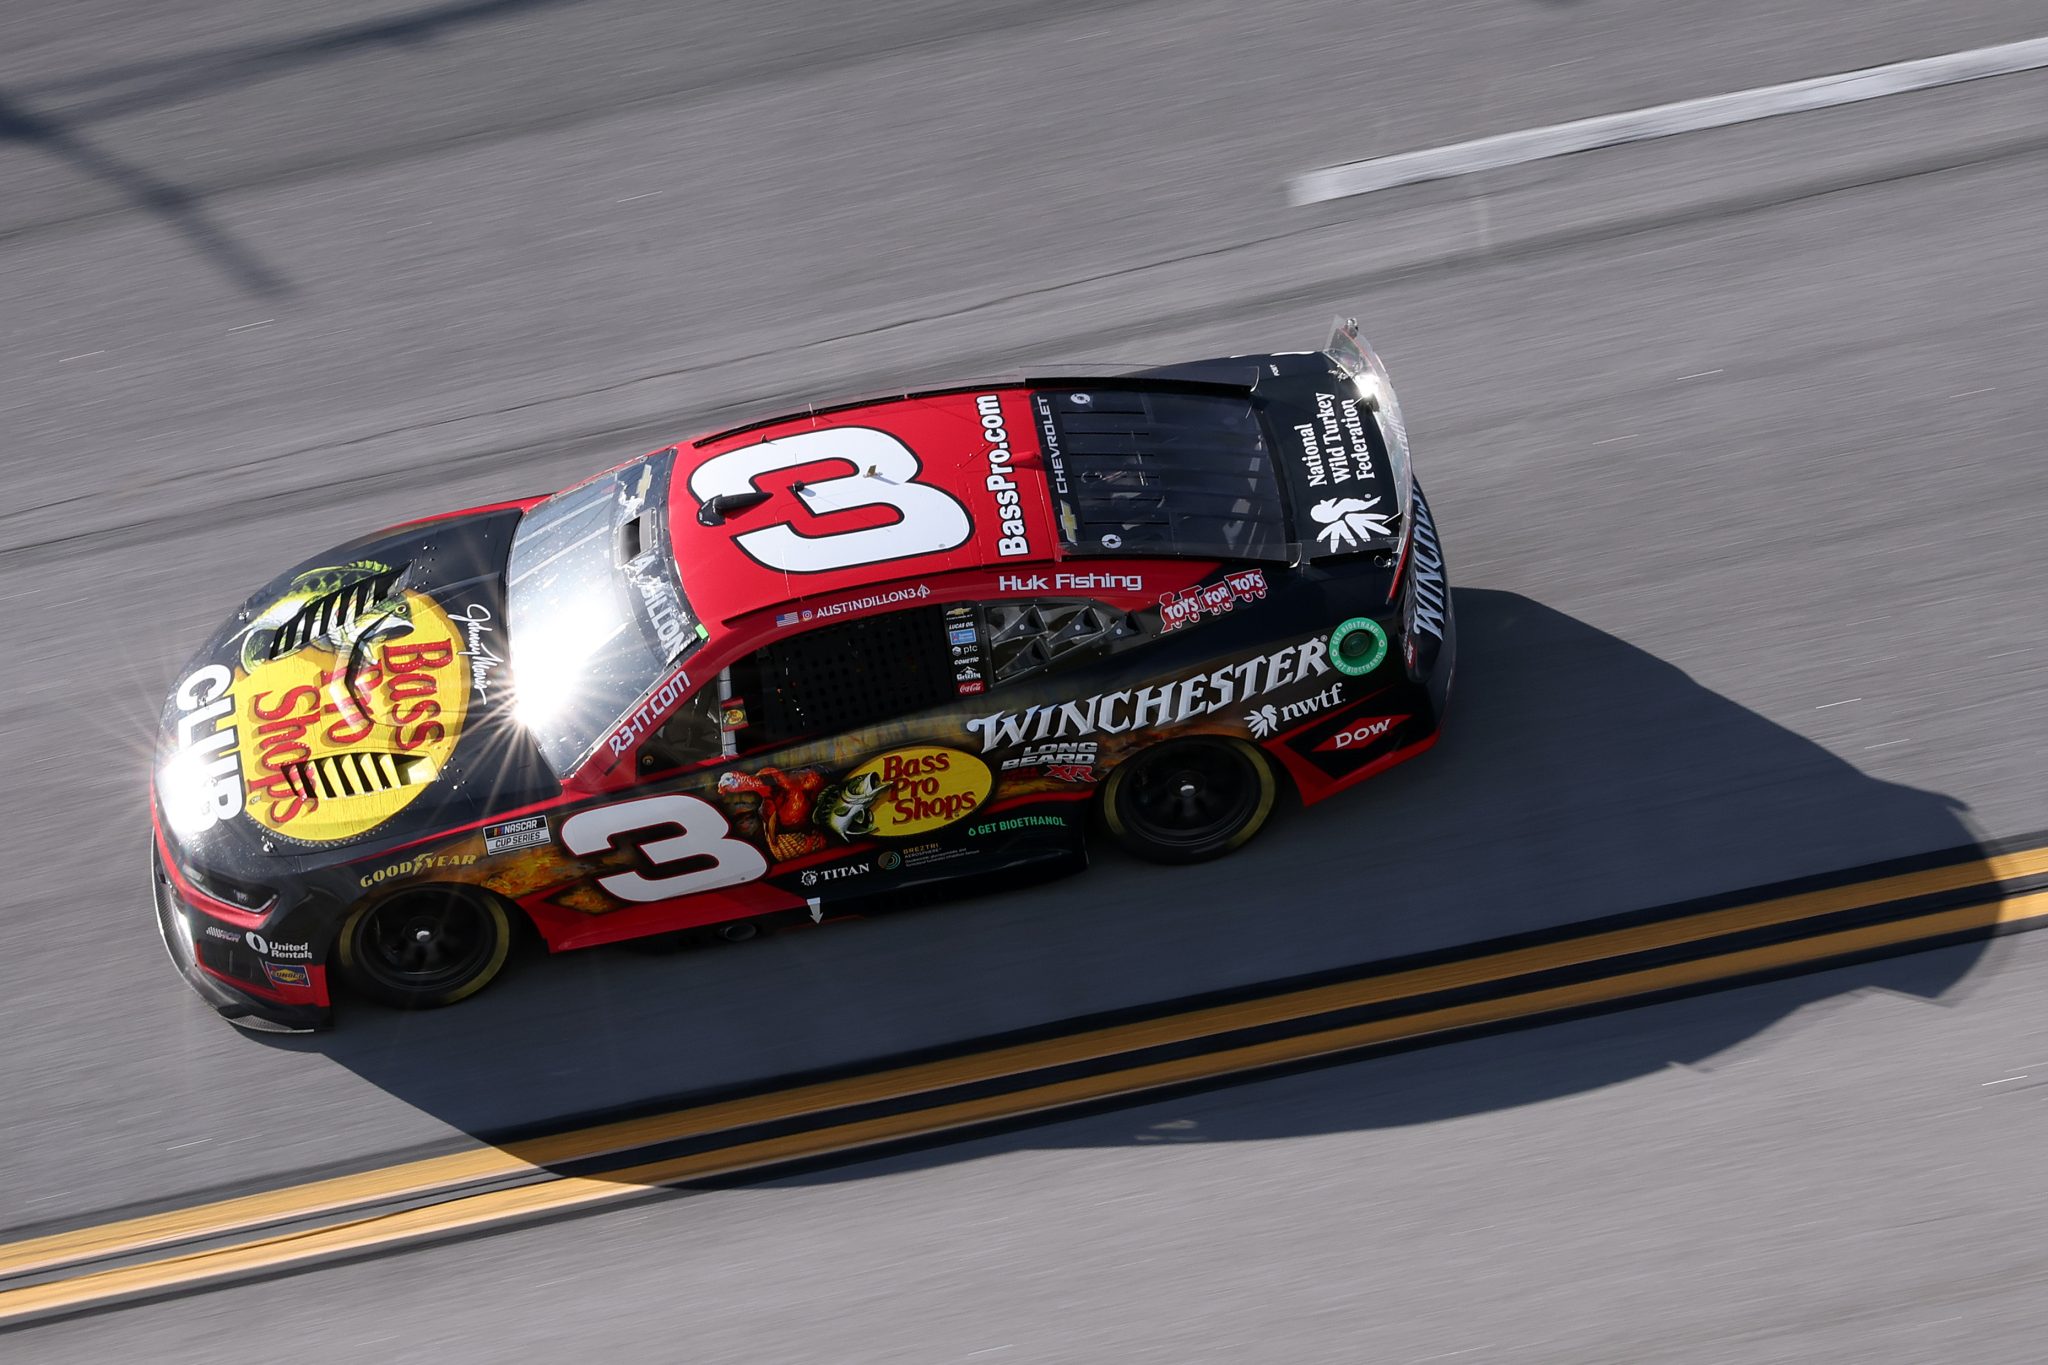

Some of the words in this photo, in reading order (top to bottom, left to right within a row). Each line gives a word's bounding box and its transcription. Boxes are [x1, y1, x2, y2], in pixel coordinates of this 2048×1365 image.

[1316, 392, 1341, 445] Turkey
[1037, 396, 1068, 493] CHEVROLET
[1294, 423, 1327, 487] National
[1341, 399, 1375, 480] Federation
[976, 394, 1029, 556] BassPro.com
[1326, 446, 1351, 484] Wild
[688, 426, 974, 573] 3
[999, 575, 1049, 591] Huk
[1055, 573, 1142, 591] Fishing
[1164, 597, 1200, 621] TOYS
[1205, 588, 1228, 607] FOR
[1231, 571, 1264, 592] TOTS
[816, 588, 916, 619] AUSTINDILLON3
[948, 622, 965, 630] LUCAS
[954, 656, 980, 665] COMETIC
[963, 645, 978, 655] ptc
[320, 659, 384, 744] Pro
[383, 638, 453, 750] Bass
[966, 637, 1330, 753] WINCHESTER
[608, 670, 691, 758] R3-IT.COM
[176, 664, 243, 832] CLUB
[247, 685, 321, 823] Shops
[1001, 754, 1095, 770] BEARD
[1023, 742, 1098, 756] LONG
[882, 752, 949, 782] Bass
[1043, 764, 1098, 783] XR
[890, 774, 940, 797] Pro
[892, 790, 977, 825] Shops
[495, 838, 512, 848] CUP
[512, 832, 541, 844] SERIES
[504, 820, 538, 834] NASCAR
[978, 823, 997, 835] GET
[999, 816, 1066, 831] BIOETHANOL
[561, 795, 767, 901] 3
[360, 853, 477, 888] GOODYEAR
[821, 863, 870, 881] TITAN
[269, 941, 309, 952] United
[271, 949, 313, 959] Rentals
